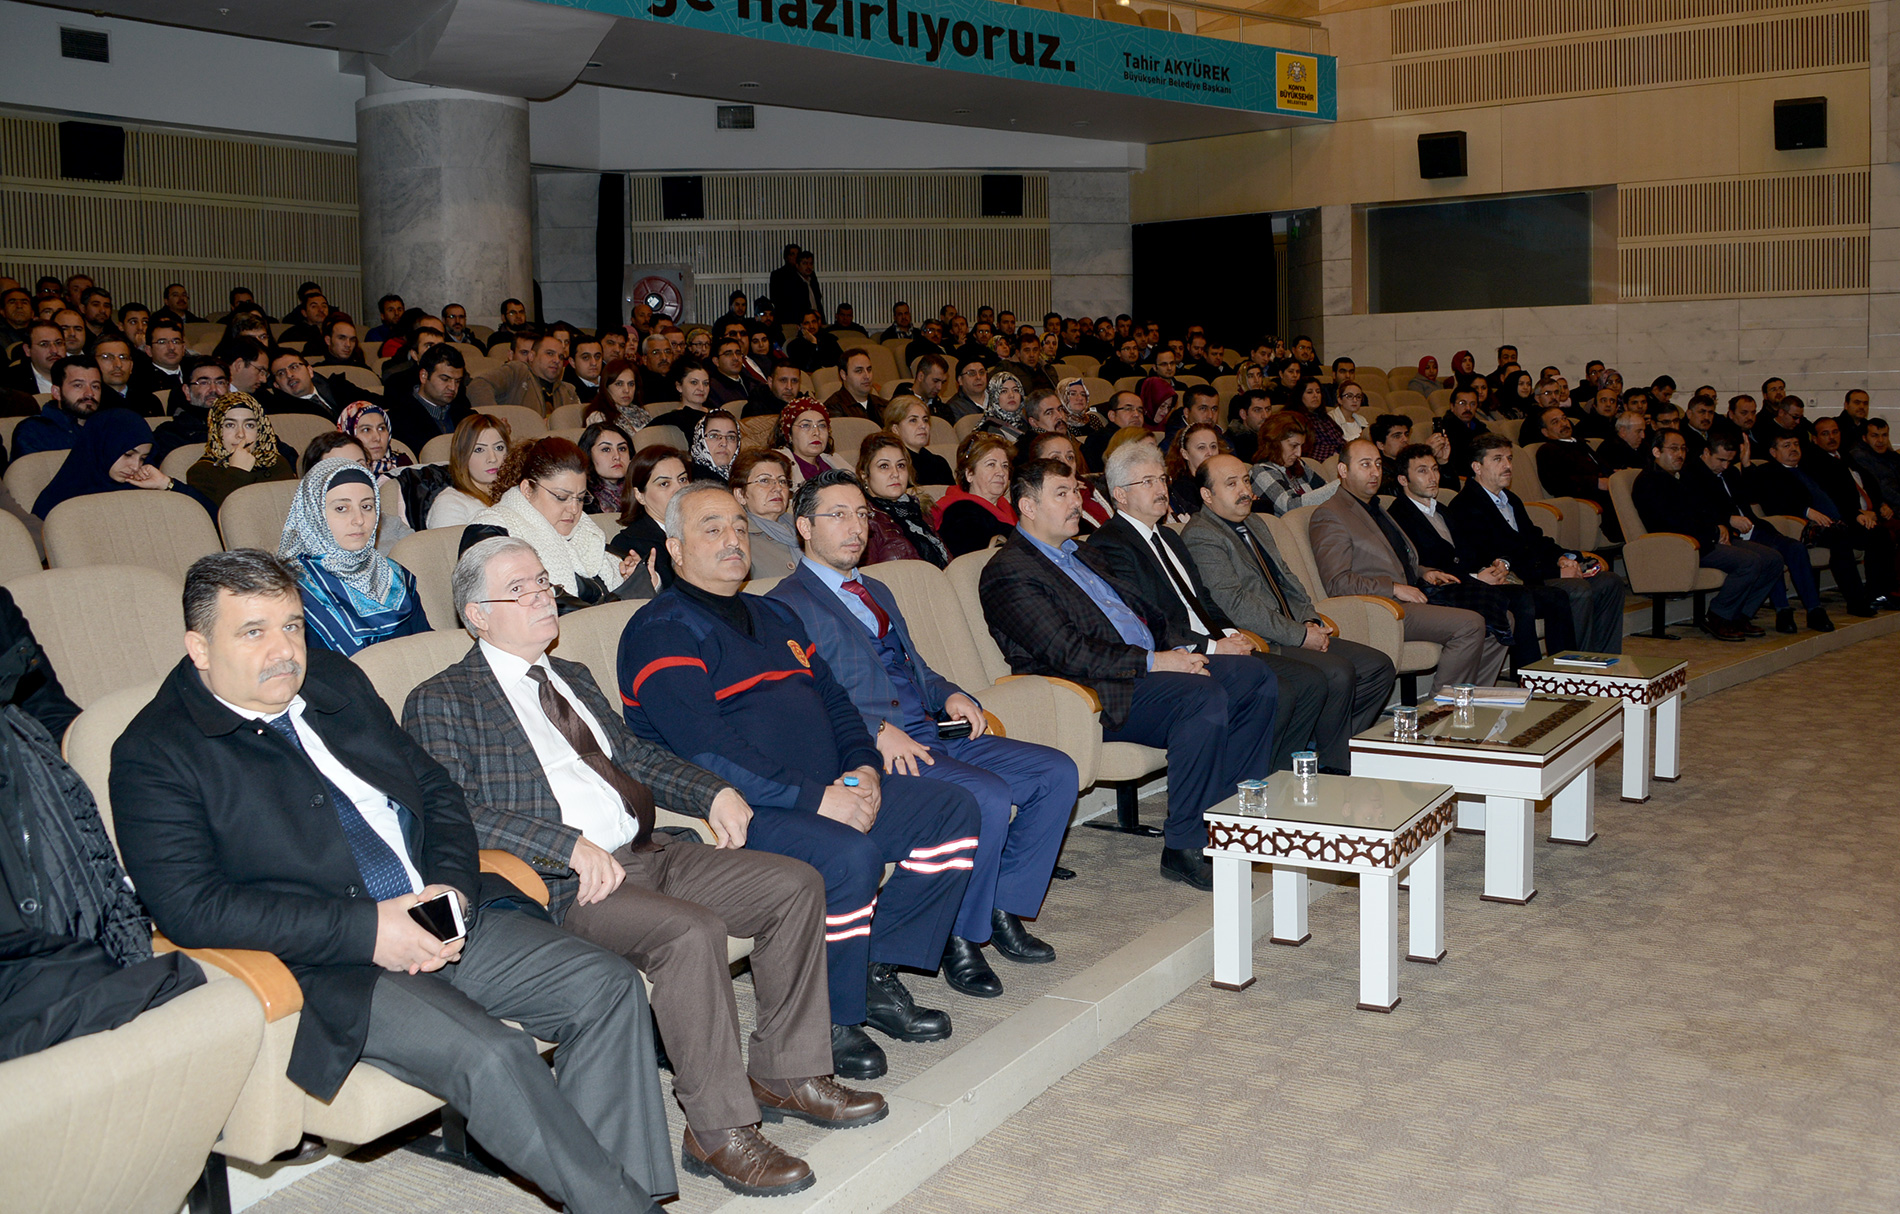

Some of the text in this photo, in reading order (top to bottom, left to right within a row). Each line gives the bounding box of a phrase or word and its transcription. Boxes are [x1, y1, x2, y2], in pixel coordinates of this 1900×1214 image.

[1123, 52, 1231, 82] Tahir AKYÜREK
[1124, 71, 1232, 94] Büyükşehir Belediye Başkanı
[1288, 84, 1306, 92] KONYA
[1280, 89, 1315, 101] BÜYÜKŞEHİR
